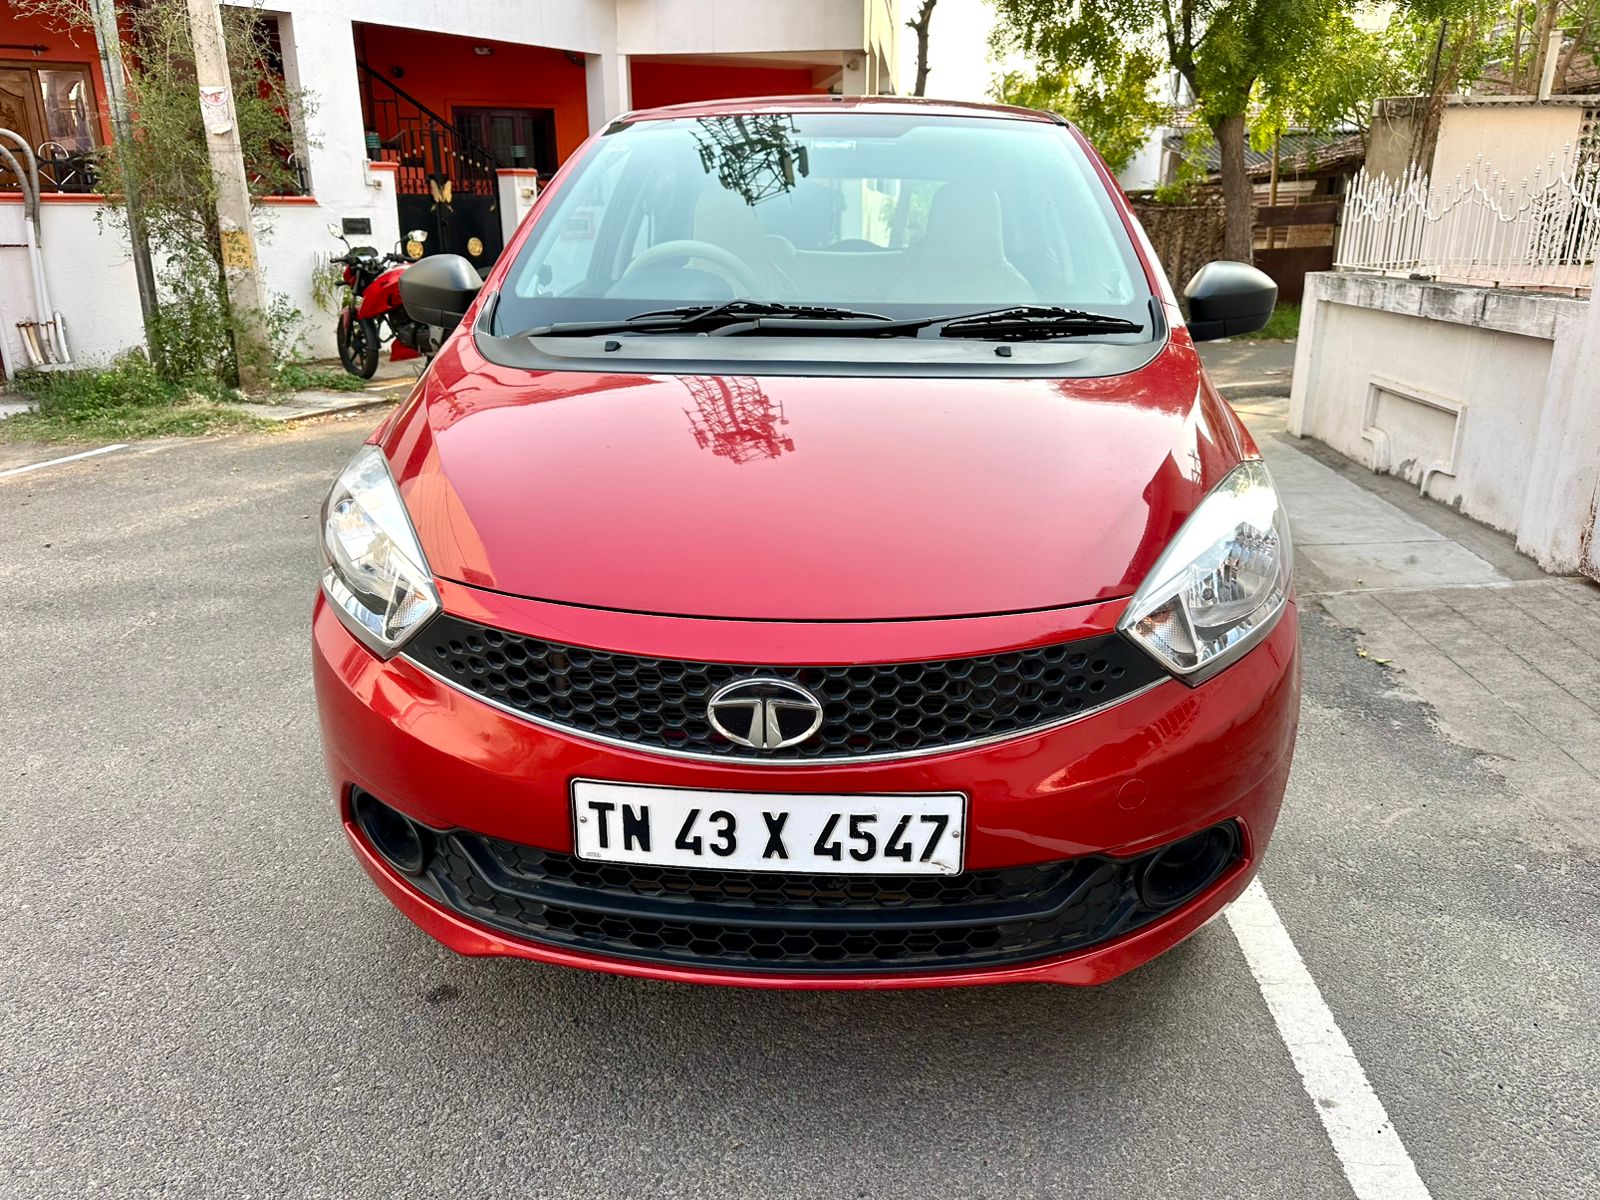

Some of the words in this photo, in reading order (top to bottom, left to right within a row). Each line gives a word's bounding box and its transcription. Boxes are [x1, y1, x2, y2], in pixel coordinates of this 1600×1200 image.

[588, 800, 651, 853] TN
[674, 808, 737, 857] 43
[762, 811, 789, 860] X
[813, 813, 949, 863] 4547
